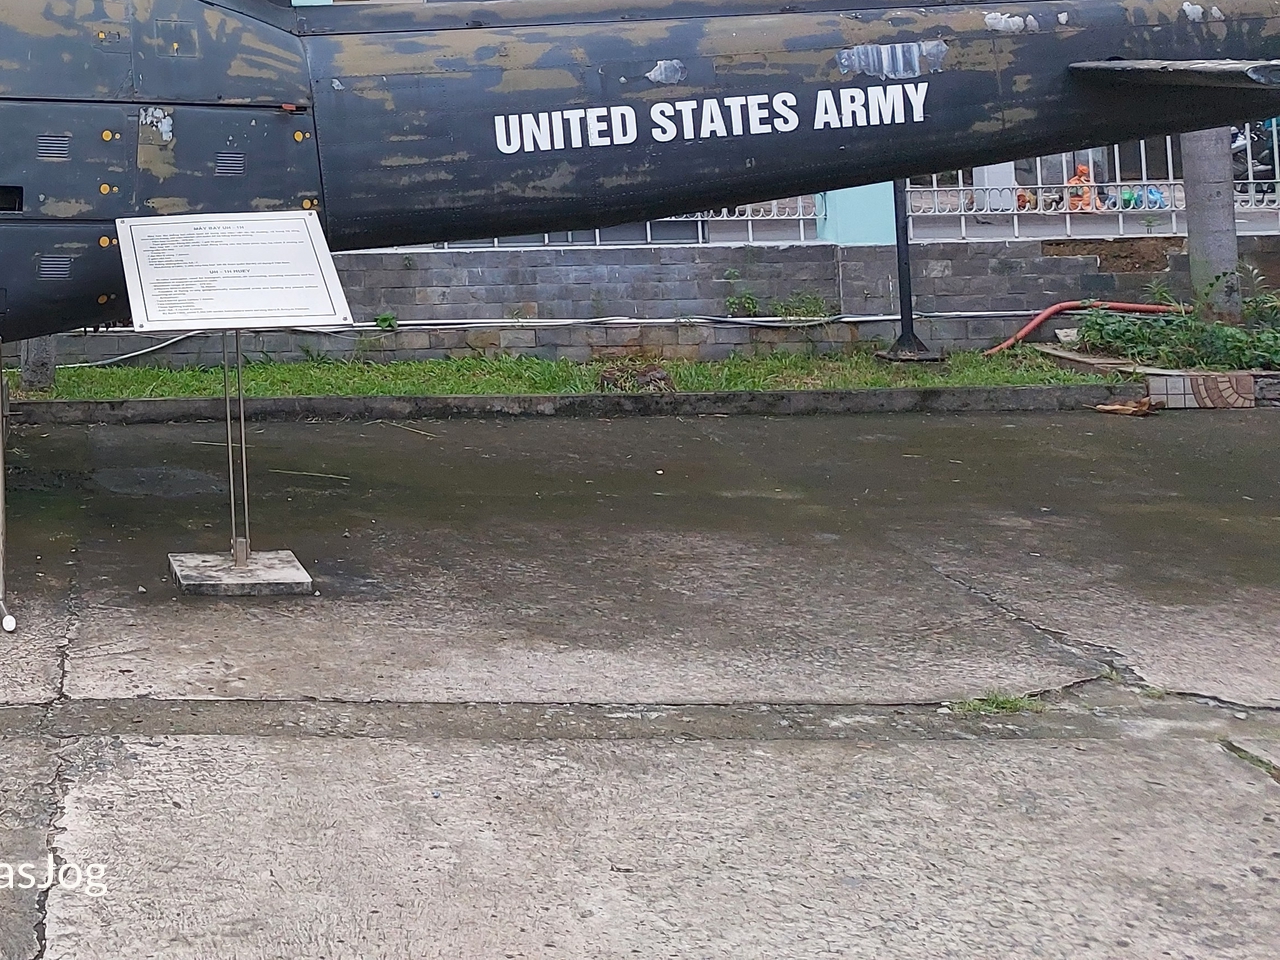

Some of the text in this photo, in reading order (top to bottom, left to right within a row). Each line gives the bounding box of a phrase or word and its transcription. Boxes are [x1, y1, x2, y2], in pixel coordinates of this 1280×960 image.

[494, 82, 929, 154] UNITED STATES ARMY
